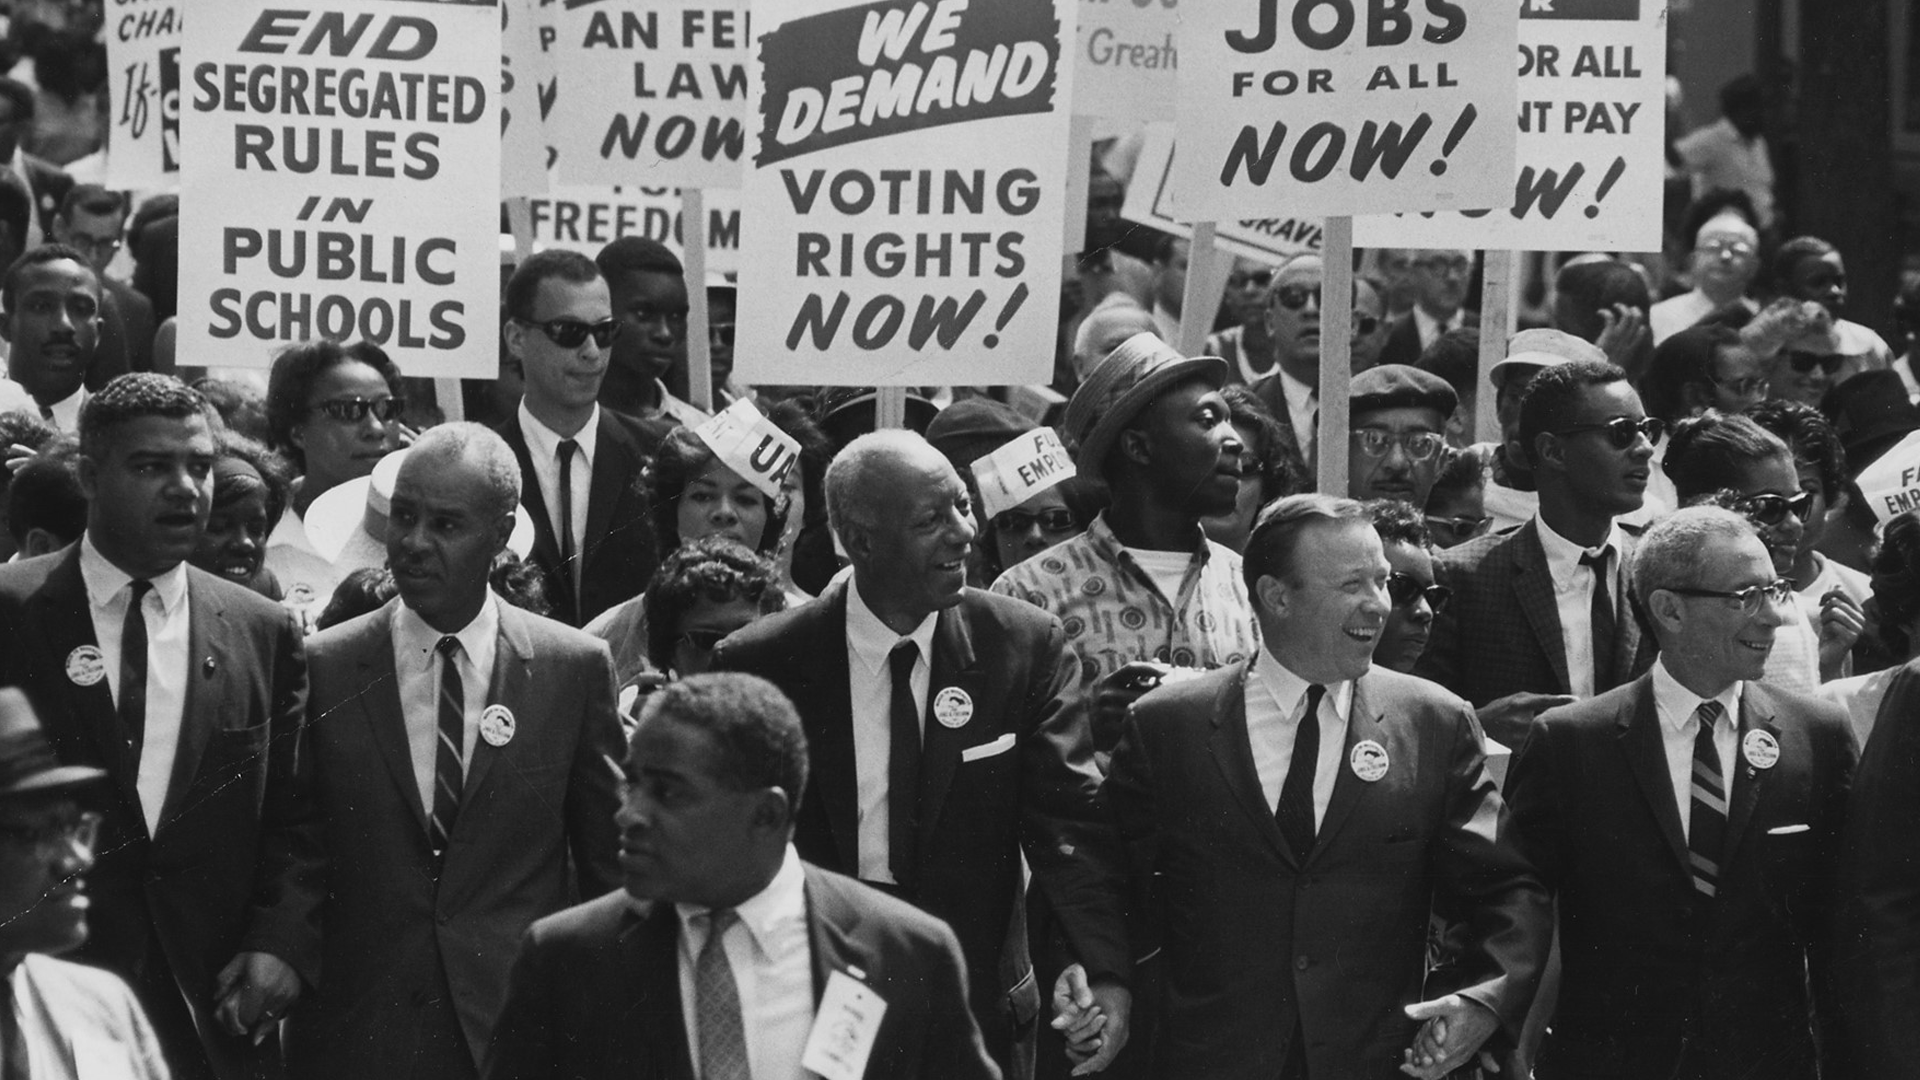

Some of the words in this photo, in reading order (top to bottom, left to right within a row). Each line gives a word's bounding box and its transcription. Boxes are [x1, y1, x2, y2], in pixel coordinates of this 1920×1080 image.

[118, 7, 182, 42] CHA
[237, 9, 438, 61] END
[583, 11, 658, 49] AN
[682, 10, 750, 48] FE
[858, 0, 968, 66] WE
[1087, 27, 1177, 69] Great
[1224, 0, 1467, 53] JOBS
[634, 62, 747, 100] LAW
[1232, 69, 1335, 97] FOR
[1366, 62, 1458, 91] ALL
[1571, 45, 1641, 78] ALL
[193, 62, 487, 124] SEGREGATED
[775, 41, 1049, 145] DEMAND
[1565, 101, 1642, 134] PAY
[235, 124, 440, 180] RULES
[600, 111, 744, 161] NOW
[1220, 103, 1477, 187] NOW!
[296, 196, 374, 223] IN
[780, 168, 1041, 216] VOTING
[223, 226, 457, 285] PUBLIC
[797, 231, 1026, 278] RIGHTS
[208, 288, 467, 350] SCHOOLS
[786, 282, 1029, 351] NOW!
